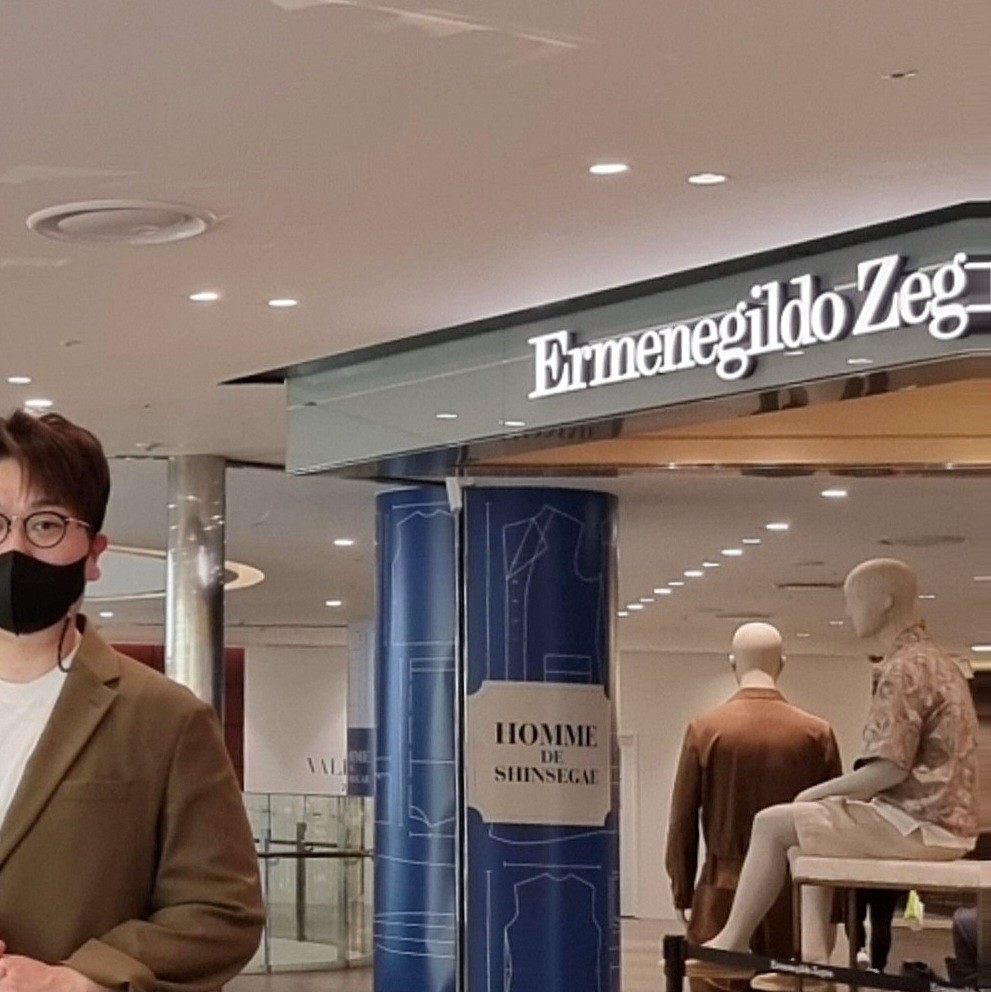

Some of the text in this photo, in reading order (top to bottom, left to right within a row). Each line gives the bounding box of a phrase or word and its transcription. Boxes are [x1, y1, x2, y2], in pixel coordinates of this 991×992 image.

[527, 251, 991, 400] Ermenegildo Zeg
[494, 721, 599, 748] HOMME
[540, 749, 565, 764] DE
[494, 766, 600, 785] SHINSEGAE
